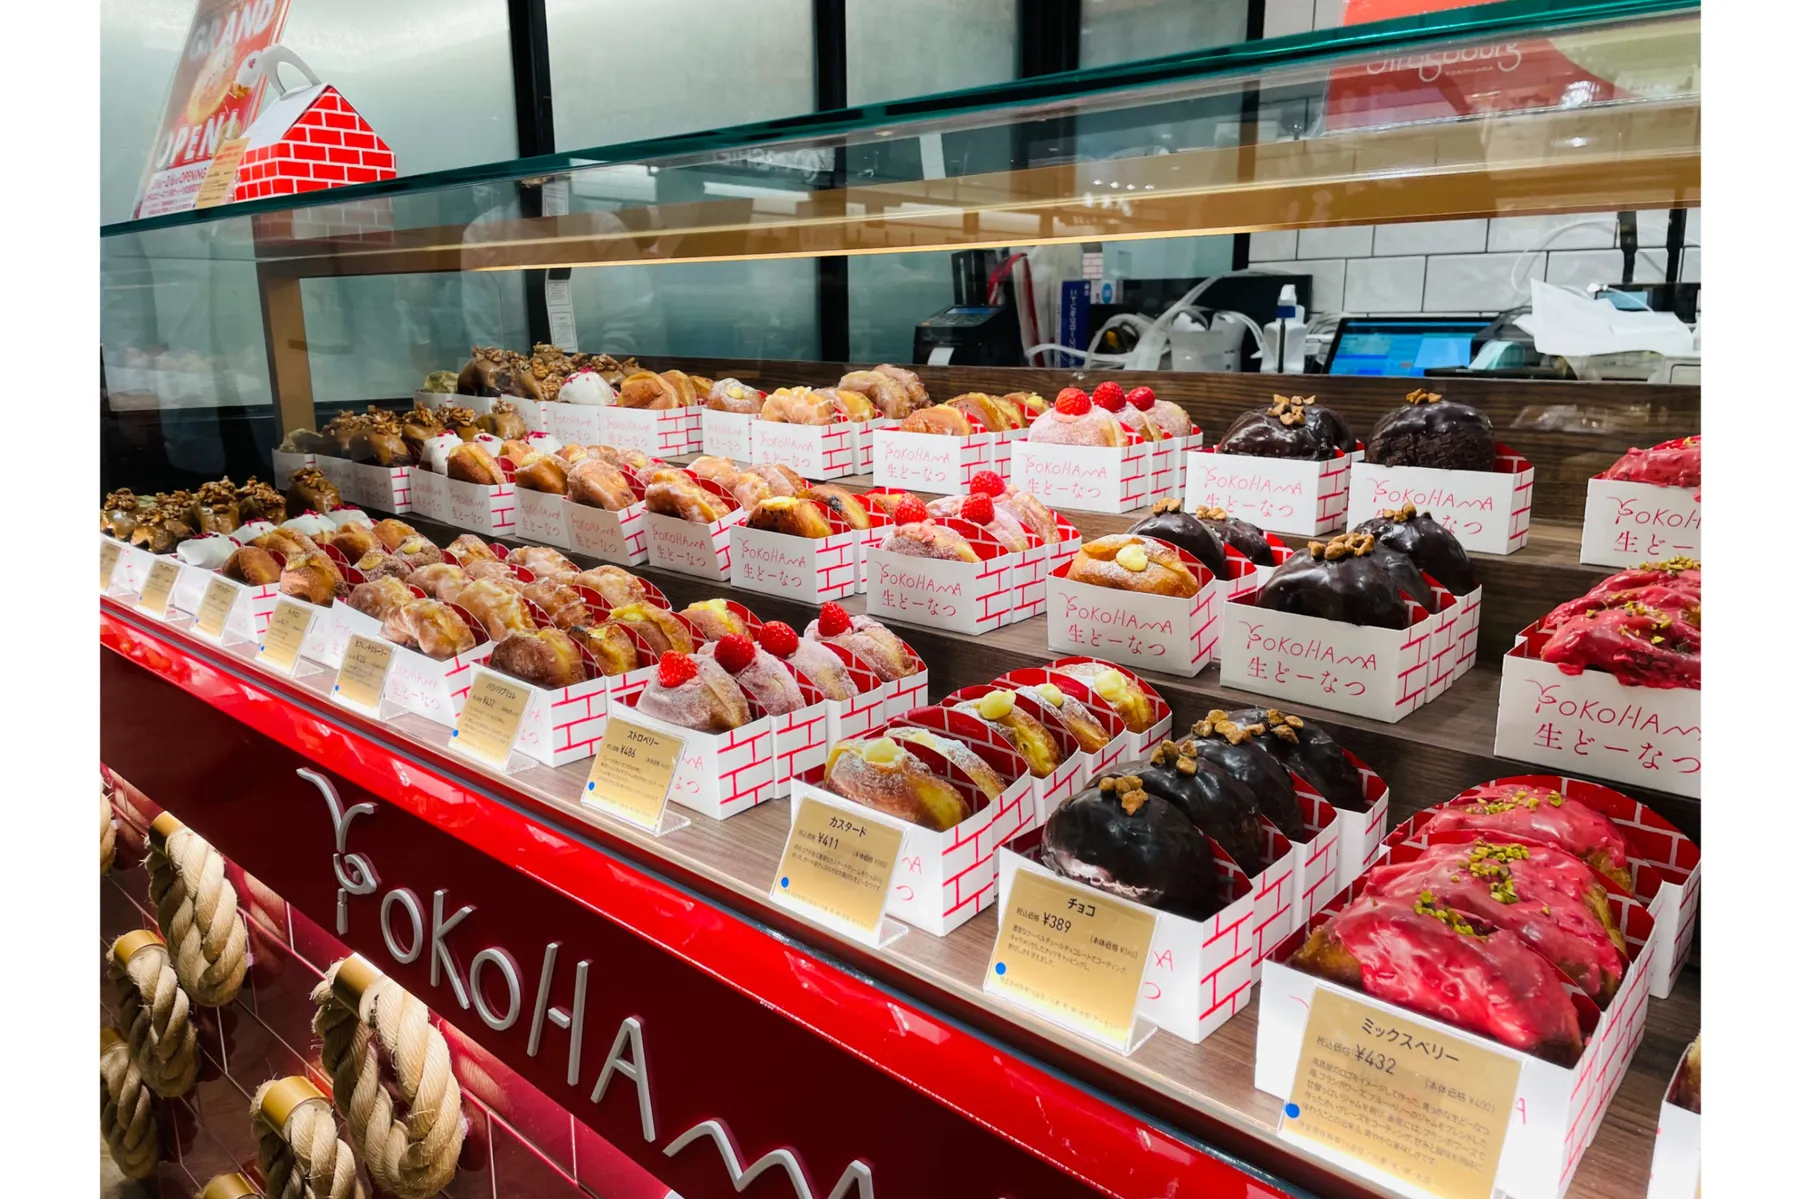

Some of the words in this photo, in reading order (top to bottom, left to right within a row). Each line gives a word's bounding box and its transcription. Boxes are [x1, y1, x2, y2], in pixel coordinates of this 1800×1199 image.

[189, 0, 275, 61] GRAND
[884, 440, 950, 464] YOKOHAMA
[1019, 453, 1107, 479] YOKOHAMA
[887, 463, 946, 482] 生どーなつ
[1199, 466, 1302, 496] YOKOHAMA
[1027, 477, 1101, 499] 生どーなつ
[1366, 477, 1493, 511] YOKOHAMA
[648, 521, 707, 551] YOKOHAMA
[656, 544, 706, 567] 生どーなつ
[737, 537, 807, 569] YOKOHAMA
[743, 562, 802, 588] 生どーなつ
[875, 561, 962, 597] YOKOHAMA
[881, 589, 957, 617] 生どーなつ
[1057, 592, 1173, 635] YOKOHAMA
[1067, 623, 1166, 656] 生どーなつ
[1238, 620, 1377, 671] YOKOHAMA
[1247, 656, 1366, 696] 生どーなつ
[1523, 678, 1700, 742] YOKOHAM
[620, 743, 637, 759] ¥486
[627, 730, 660, 747] ストロベリー
[1533, 722, 1700, 774] 生どーなつ
[817, 831, 839, 850] ¥411
[829, 816, 868, 838] カスタード
[1043, 911, 1072, 934] ¥389
[1067, 897, 1097, 918] チョコ
[1361, 1017, 1460, 1063] ミックスベリー
[1354, 1044, 1397, 1076] ¥432
